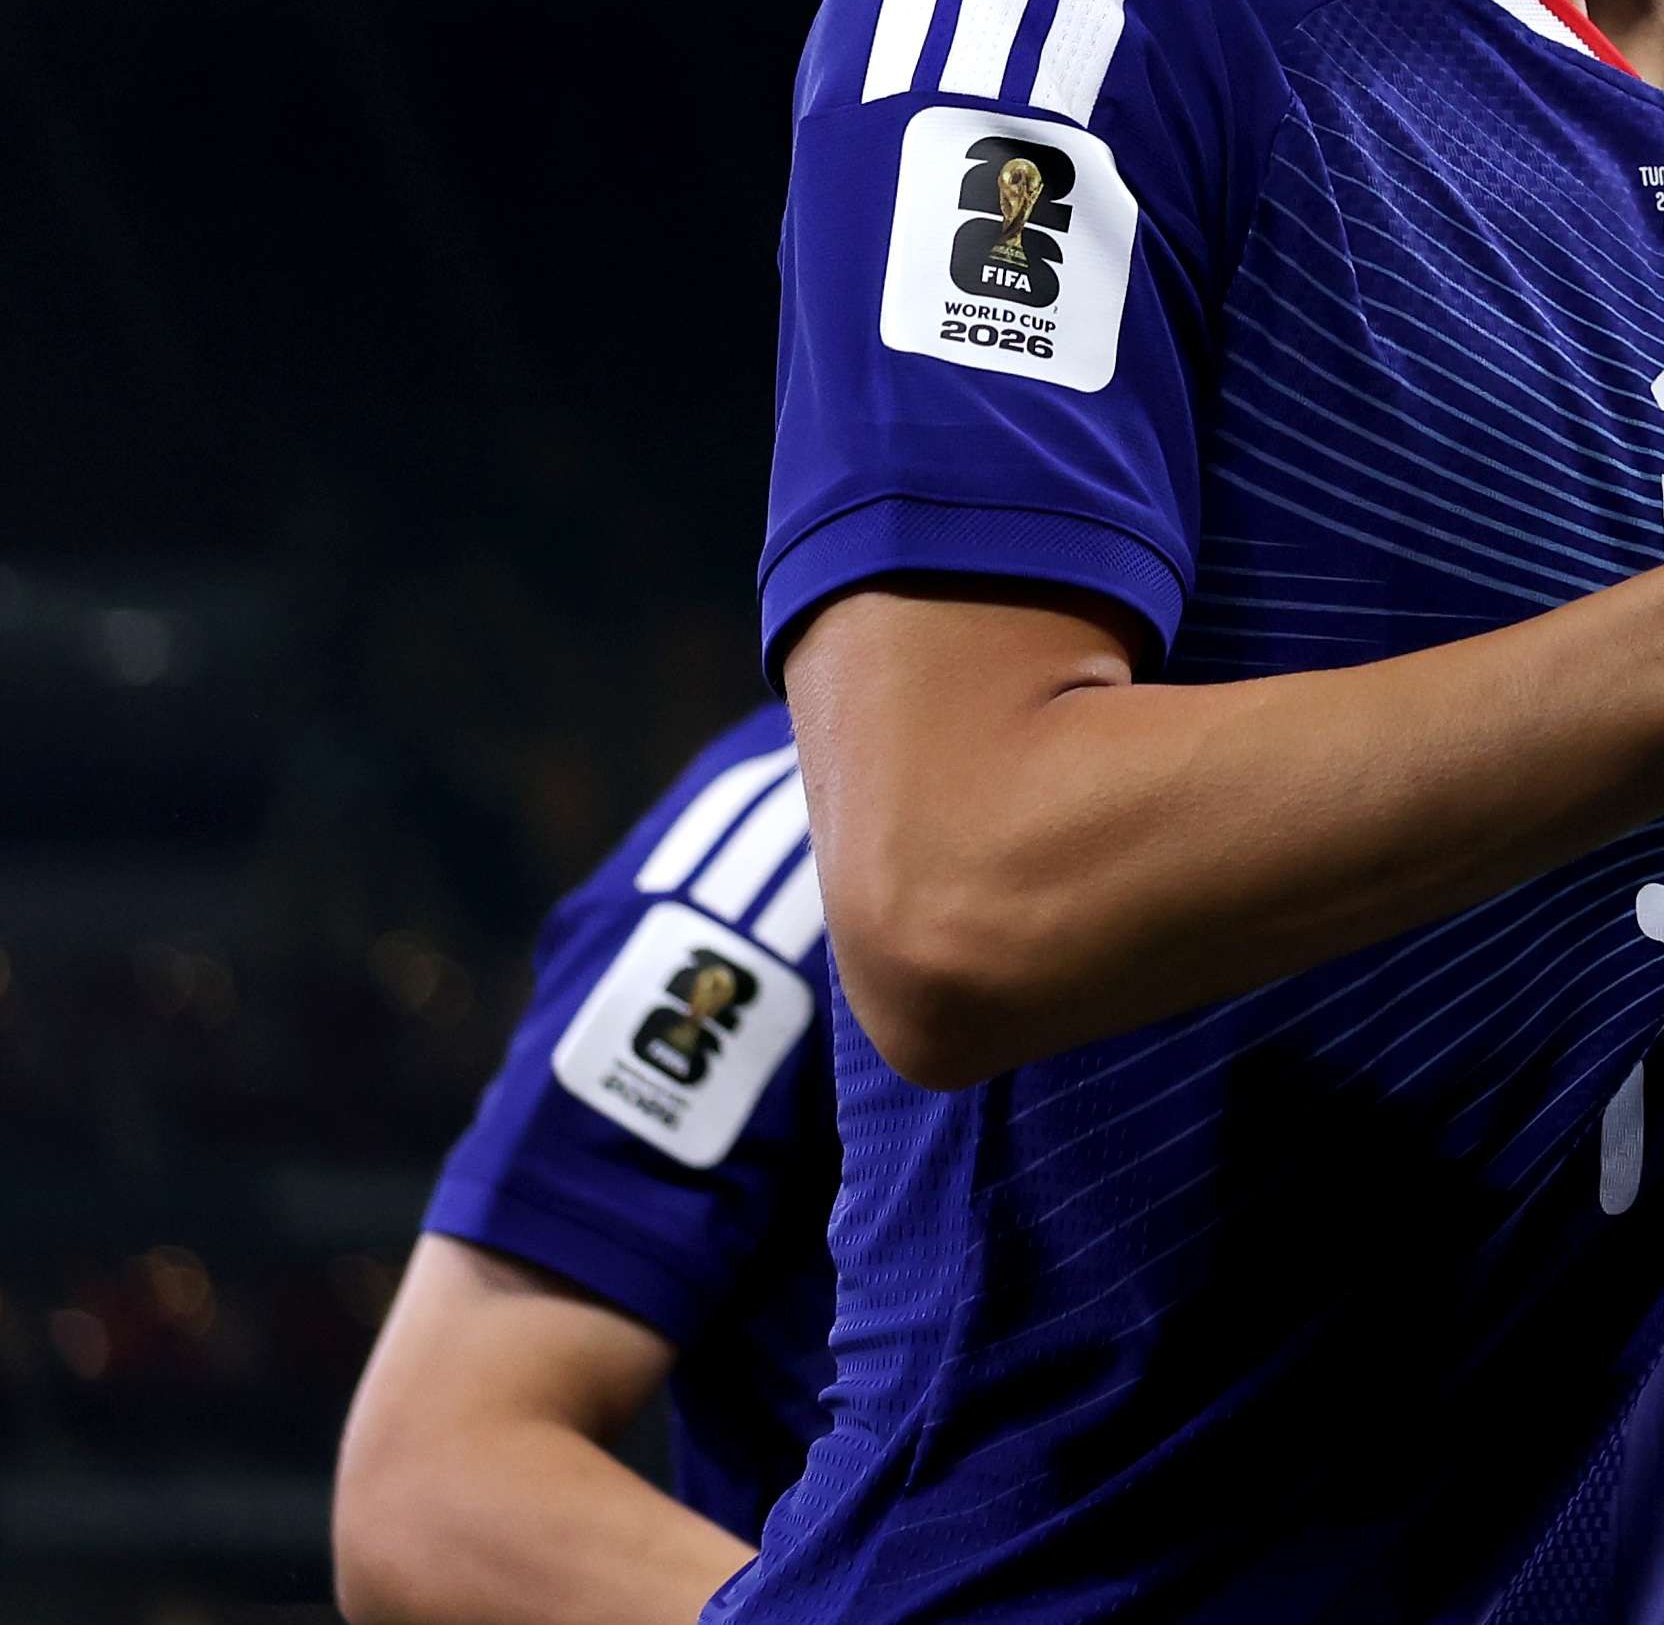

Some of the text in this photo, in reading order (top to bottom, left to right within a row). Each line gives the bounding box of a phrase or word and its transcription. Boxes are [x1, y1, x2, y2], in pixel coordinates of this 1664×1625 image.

[981, 264, 1032, 293] FIFA
[944, 301, 1057, 334] WORLD CUP
[939, 320, 1055, 360] 2026
